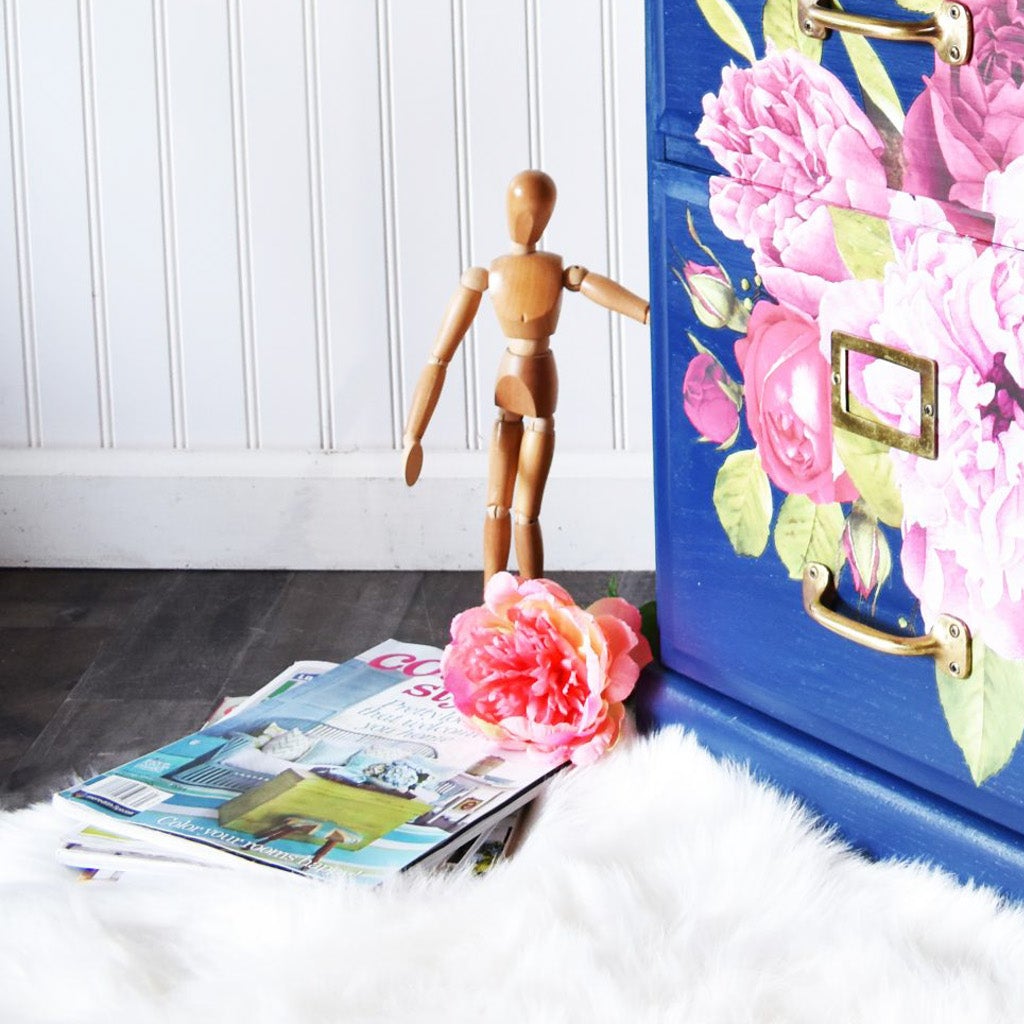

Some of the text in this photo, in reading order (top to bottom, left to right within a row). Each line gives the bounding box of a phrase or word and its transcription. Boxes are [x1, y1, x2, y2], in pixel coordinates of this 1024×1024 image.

[156, 815, 203, 831] Color
[198, 827, 244, 845] your
[242, 840, 299, 862] rooms
